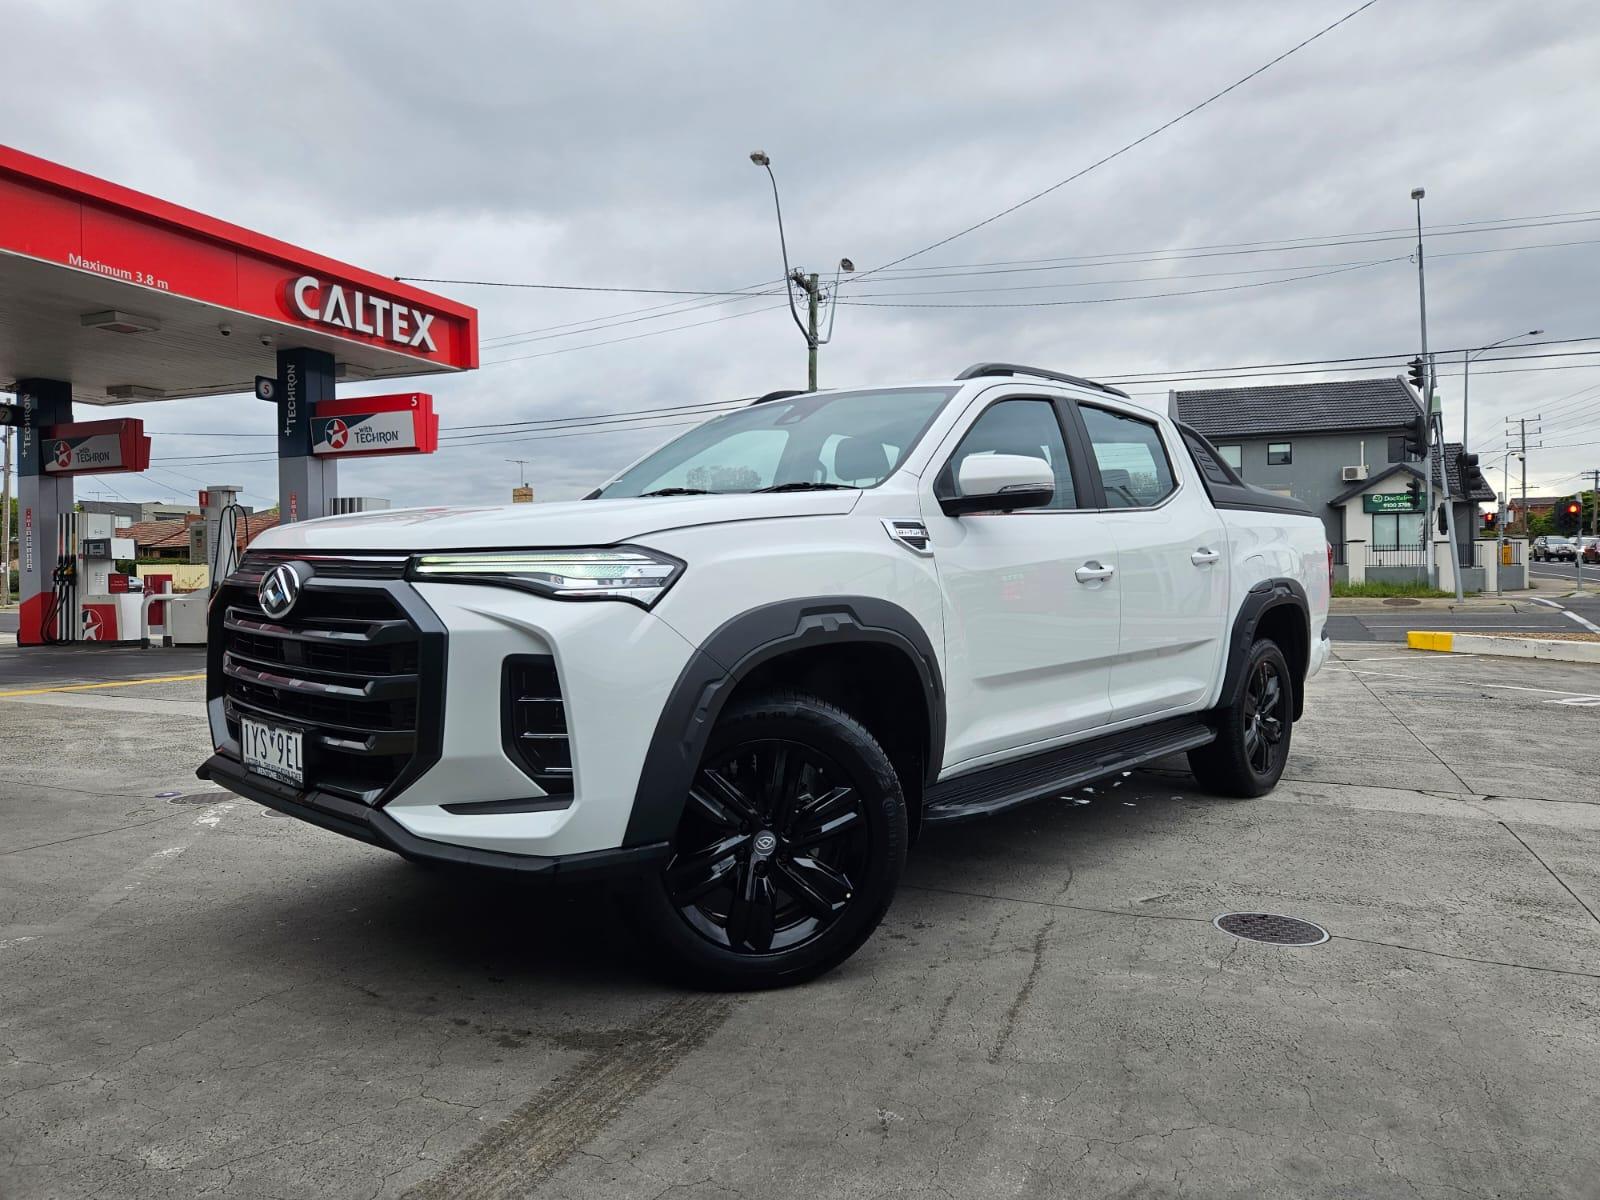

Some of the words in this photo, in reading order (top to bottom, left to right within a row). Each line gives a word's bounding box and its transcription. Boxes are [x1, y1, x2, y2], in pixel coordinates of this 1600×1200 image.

[68, 252, 132, 280] Maximum
[135, 271, 154, 285] 3.8
[156, 279, 169, 290] m
[294, 276, 438, 352] CALTEX
[263, 384, 270, 395] 5
[410, 395, 418, 407] 5
[358, 425, 373, 433] with
[354, 430, 399, 445] TECHRON
[76, 451, 110, 463] TECHRON
[245, 723, 268, 760] 1YS
[277, 732, 302, 772] 9EL
